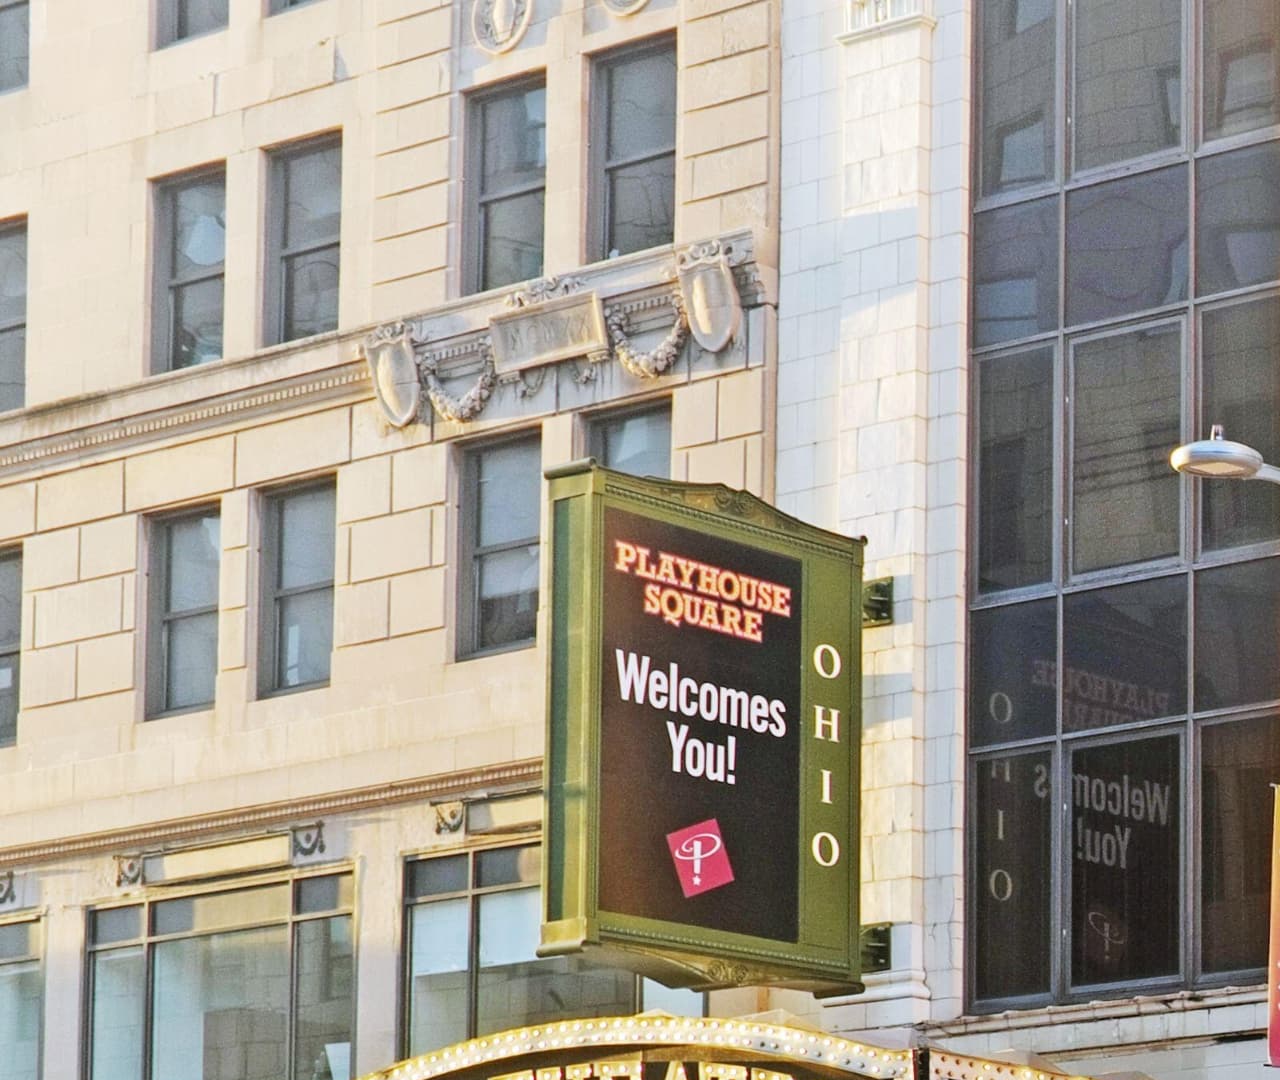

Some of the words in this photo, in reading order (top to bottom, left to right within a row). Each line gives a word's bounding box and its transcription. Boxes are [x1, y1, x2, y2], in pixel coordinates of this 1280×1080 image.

[615, 540, 791, 618] PLAYHOUSE
[644, 584, 763, 643] SQUARE
[615, 648, 787, 738] Welcomes
[666, 720, 737, 784] You!
[812, 643, 842, 868] OHIO
